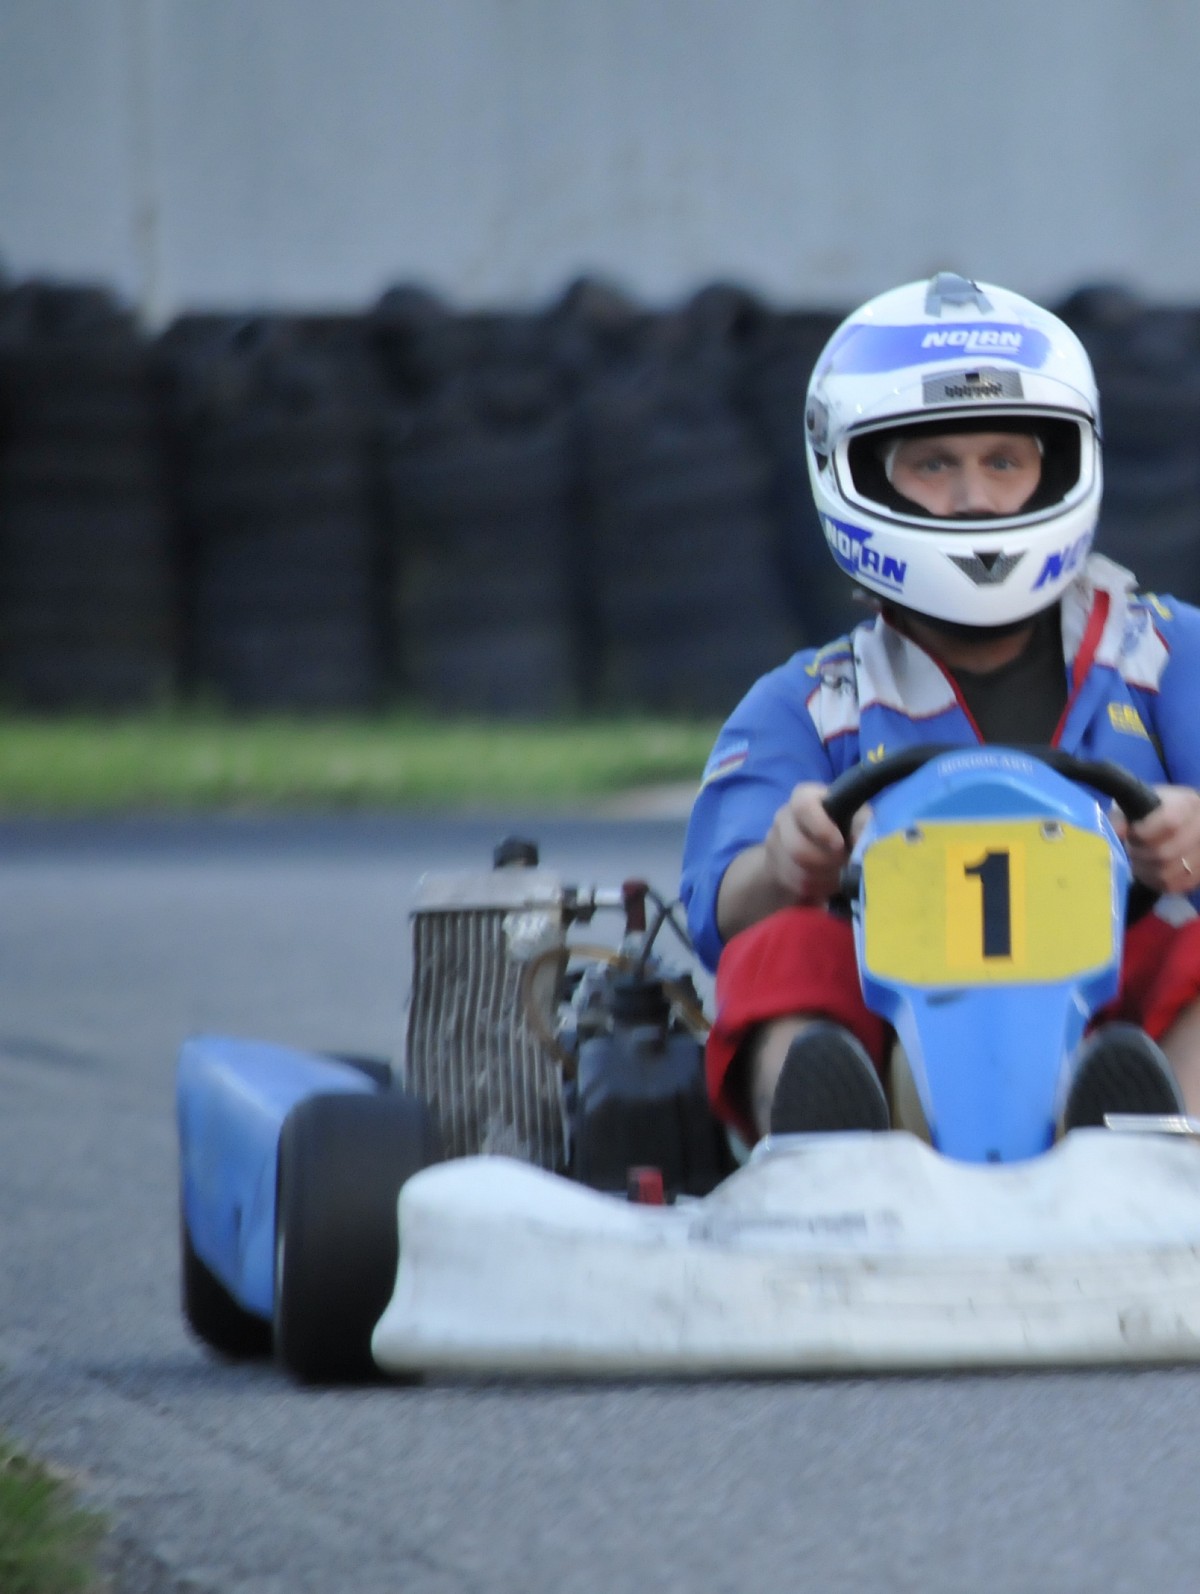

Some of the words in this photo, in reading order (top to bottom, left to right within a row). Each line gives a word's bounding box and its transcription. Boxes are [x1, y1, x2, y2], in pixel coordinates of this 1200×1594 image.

[921, 329, 1022, 353] NOLAN
[823, 517, 907, 588] NOLAN
[964, 848, 1013, 961] 1
